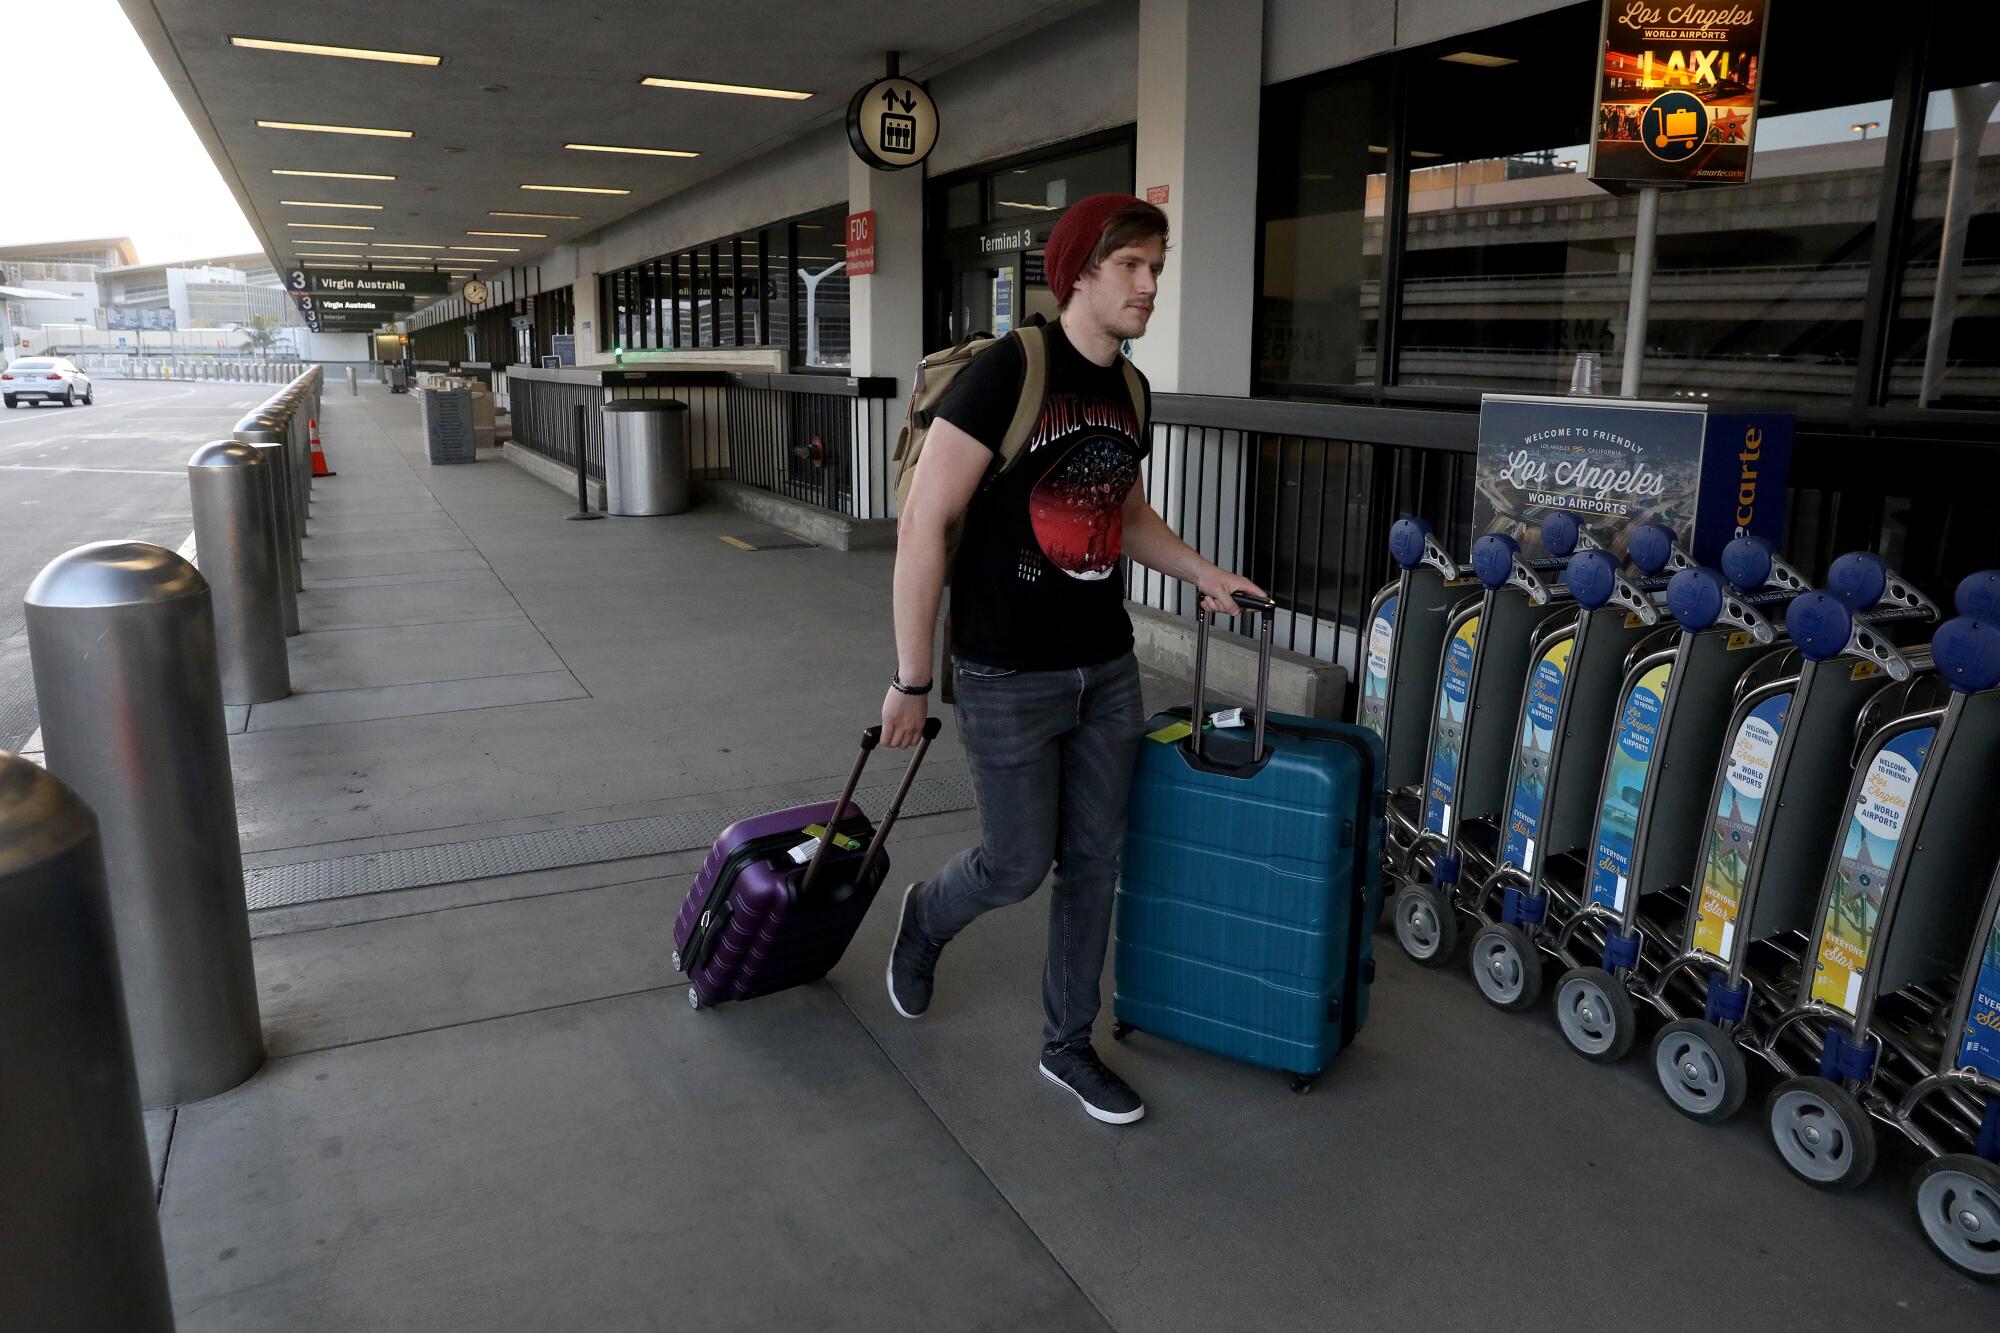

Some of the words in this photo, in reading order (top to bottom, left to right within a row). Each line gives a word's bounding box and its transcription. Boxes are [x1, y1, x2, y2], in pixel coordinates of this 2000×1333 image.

[1619, 1, 1661, 29] Los
[1668, 4, 1753, 31] Angeles
[1645, 30, 1677, 38] WORLD
[1680, 31, 1726, 39] AIRPORTS
[1642, 50, 1719, 87] LAX
[851, 217, 868, 242] FDC
[980, 231, 1020, 252] Terminal
[1024, 229, 1031, 246] 3
[292, 271, 306, 289] 3
[322, 279, 354, 290] Virgin
[357, 280, 406, 290] Australia
[302, 296, 312, 309] 3
[323, 302, 344, 310] Virgin
[308, 311, 316, 320] 3
[1524, 428, 1571, 445] WELCOME
[1576, 428, 1588, 436] TO
[1594, 430, 1644, 454] FRIENDLY
[1588, 448, 1622, 456] CALIFORNIA
[1500, 450, 1548, 490] Los
[1555, 458, 1665, 500] Angeles
[1528, 492, 1566, 507] WORLD
[1568, 498, 1627, 515] AIRPORTS
[1634, 692, 1654, 704] WELCOME
[1531, 708, 1552, 722] AIRPORTS
[1538, 702, 1554, 714] WORLD
[1640, 702, 1658, 712] FRIENDLY
[1632, 732, 1650, 744] WORLD
[1746, 724, 1770, 738] WELCOME
[1623, 738, 1648, 752] AIRPORTS
[1752, 734, 1773, 746] FRIENDLY
[1742, 766, 1764, 780] WORLD
[1879, 758, 1907, 774] WELCOME
[1732, 772, 1762, 788] AIRPORTS
[1868, 774, 1888, 788] Los
[1886, 769, 1912, 783] FRIENDLY
[1868, 786, 1906, 808] Angeles
[1514, 809, 1536, 826] EVERYONE
[1862, 809, 1898, 830] AIRPORTS
[1874, 803, 1899, 820] WORLD
[1600, 844, 1628, 864] EVERYONE
[1706, 886, 1736, 908] EVERYONE
[1826, 932, 1864, 957] EVERYONE
[1824, 946, 1854, 970] Star
